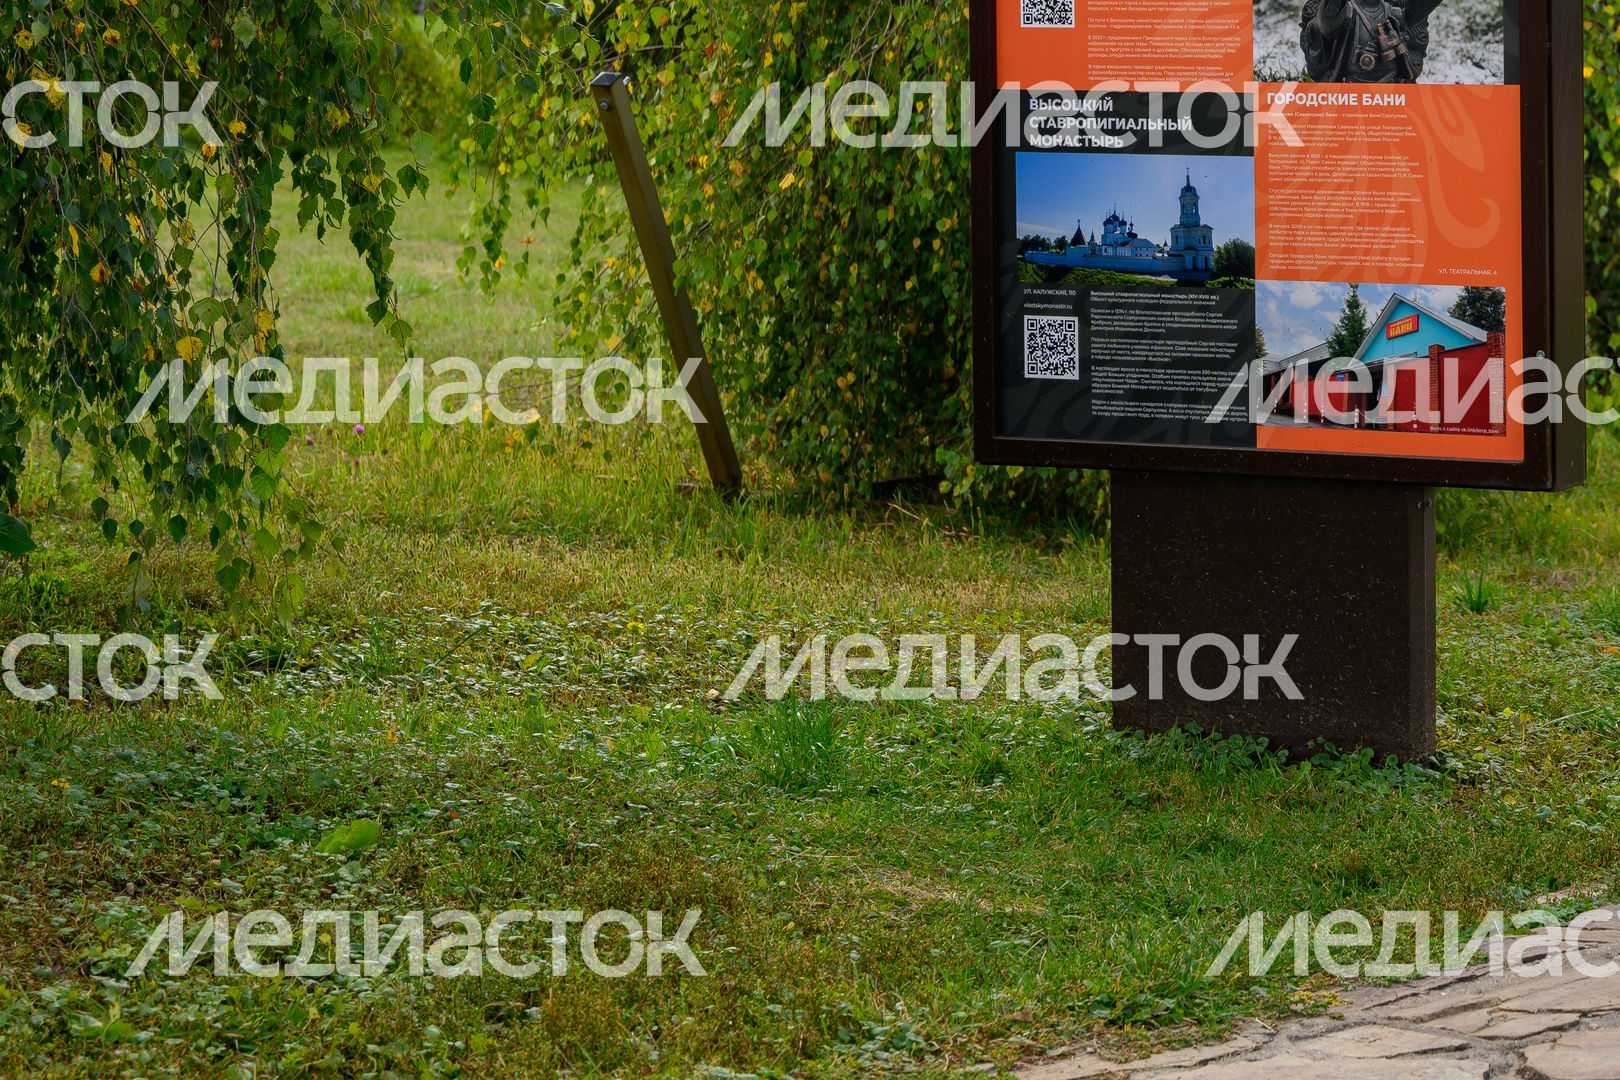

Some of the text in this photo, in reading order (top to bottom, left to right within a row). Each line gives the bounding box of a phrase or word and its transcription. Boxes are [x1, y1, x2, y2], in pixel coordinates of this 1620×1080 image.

[1030, 96, 1113, 113] ВЫСОЦКИЙ
[1267, 92, 1405, 107] ГОРОДСКИЕ БАНИ
[1030, 116, 1192, 131] СТАВРОПИГИАЛЬНЫЙ
[1030, 134, 1124, 148] МОНАСТЫРЬ
